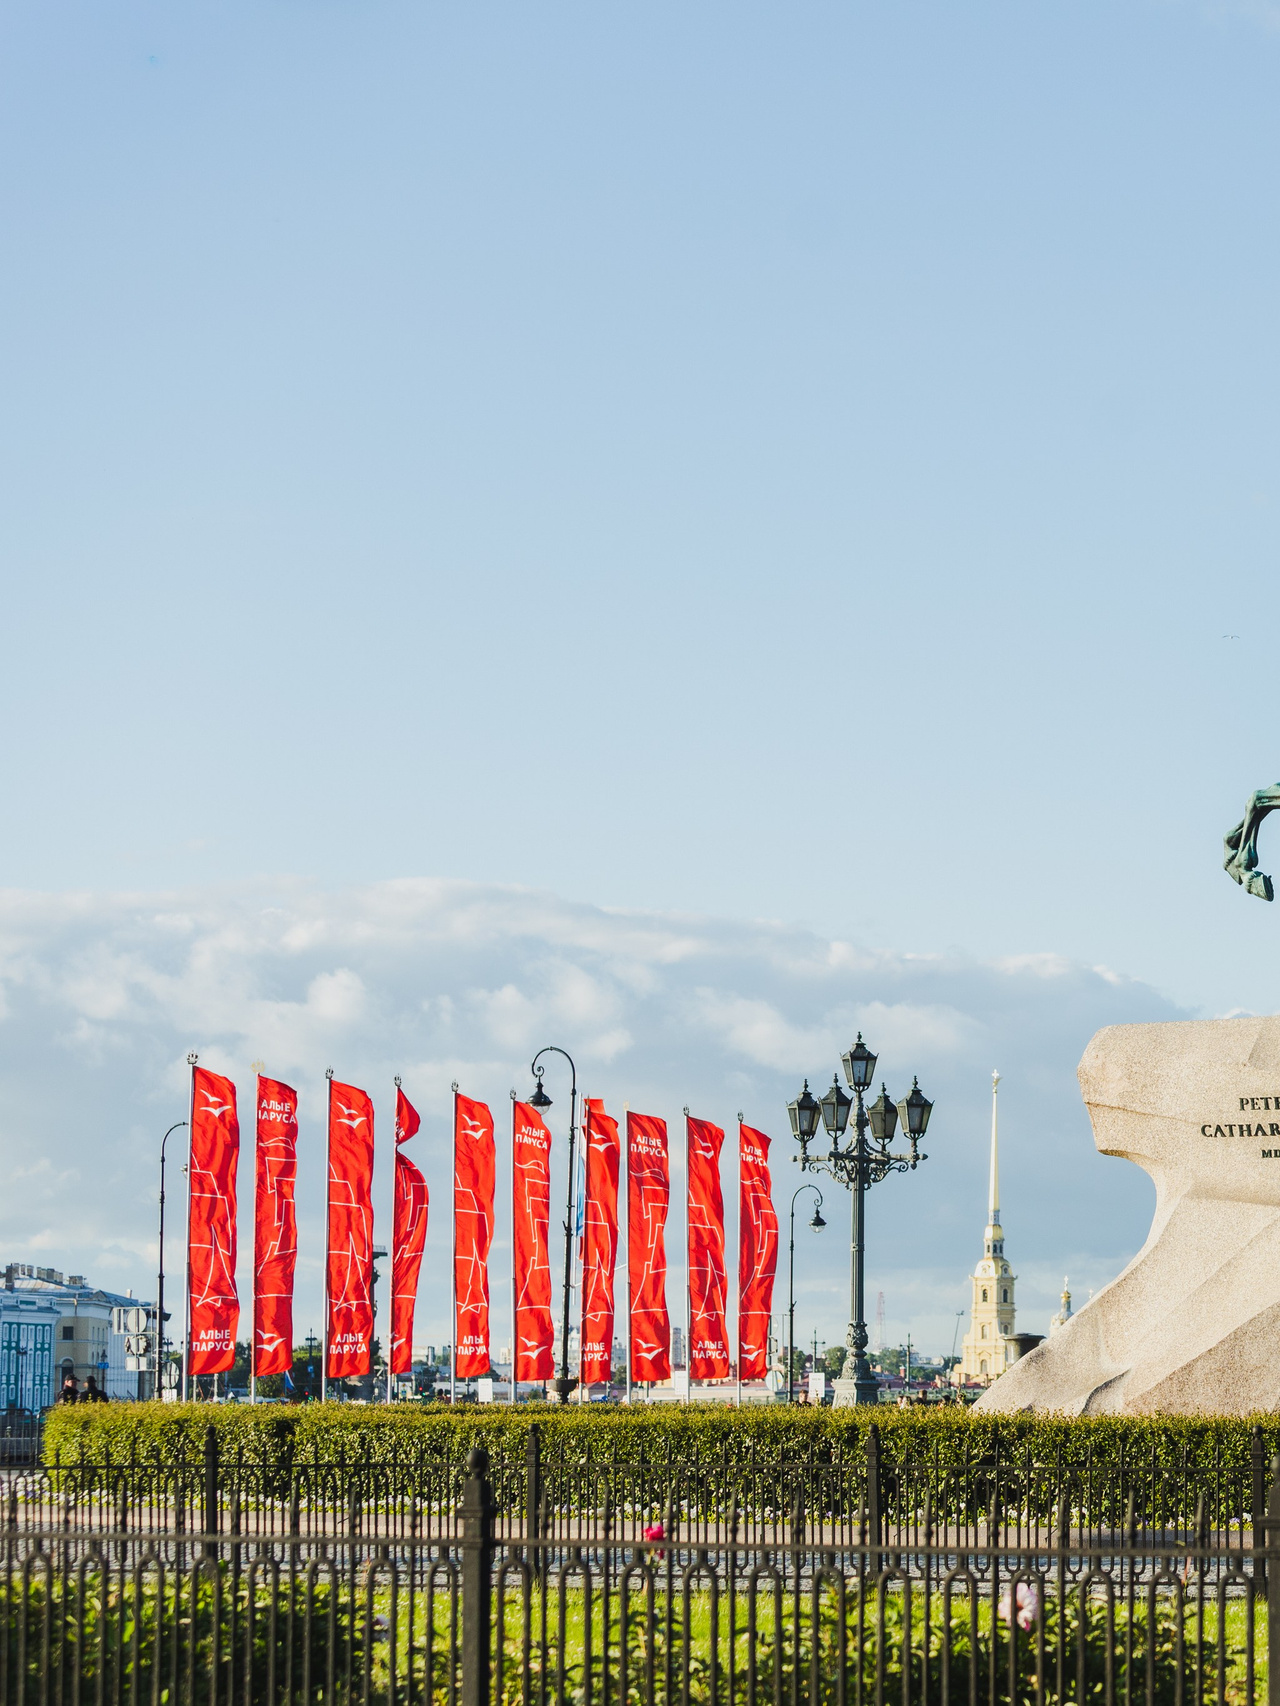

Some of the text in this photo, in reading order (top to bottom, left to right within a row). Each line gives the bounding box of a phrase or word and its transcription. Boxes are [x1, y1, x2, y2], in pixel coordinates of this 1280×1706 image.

[261, 1099, 291, 1112] АЛЫЕ
[636, 1134, 662, 1147] АЛЫЕ
[630, 1143, 667, 1158] ПАРУСА
[199, 1329, 230, 1340] АЛЫЕ
[335, 1332, 364, 1343] АЛЫЕ
[192, 1340, 235, 1352] ПАРУСА
[329, 1343, 367, 1355] ПАРУСА
[697, 1340, 724, 1350] АЛЫЕ
[692, 1350, 728, 1360] ПАРУСА
